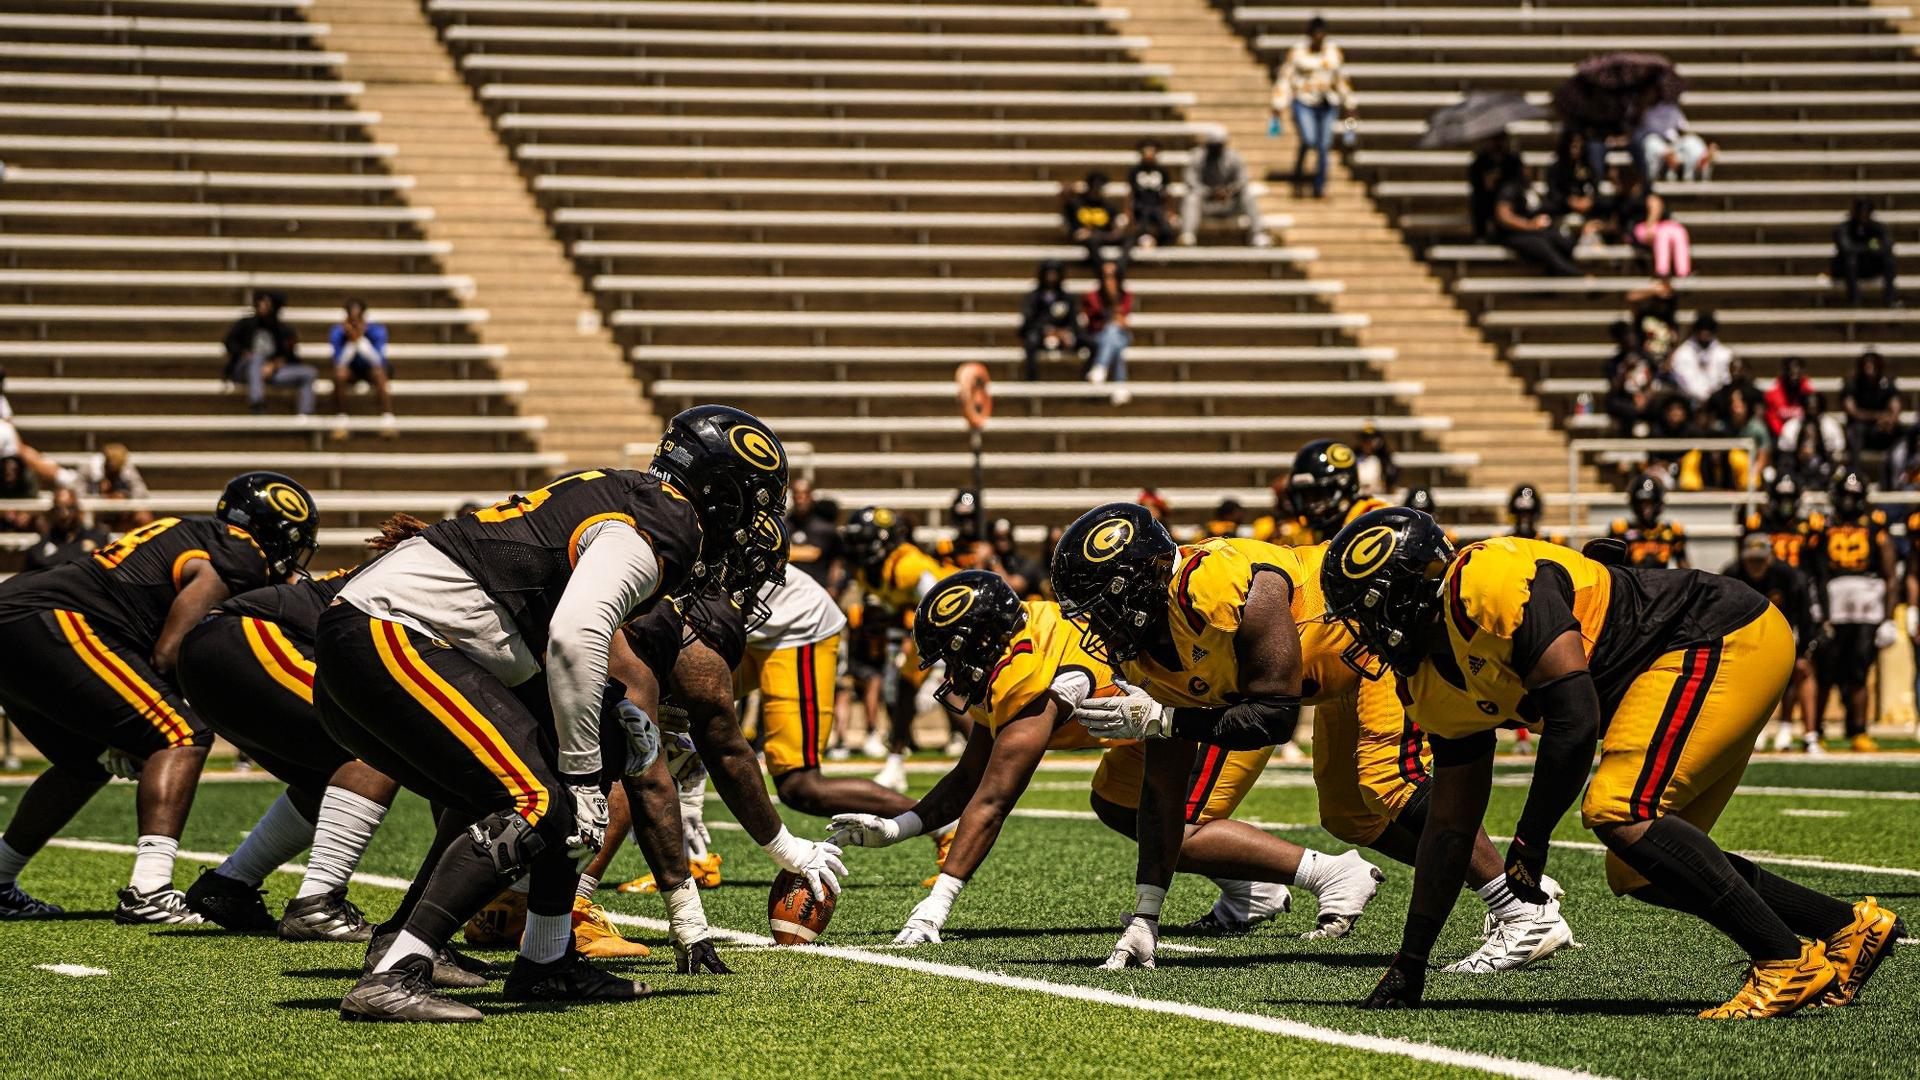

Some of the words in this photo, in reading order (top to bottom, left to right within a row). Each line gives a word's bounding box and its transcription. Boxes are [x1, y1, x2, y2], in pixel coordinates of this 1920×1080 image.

[729, 425, 780, 471] G
[266, 483, 309, 522] G
[1083, 518, 1134, 563] G
[1341, 526, 1396, 579] G
[928, 585, 975, 627] G
